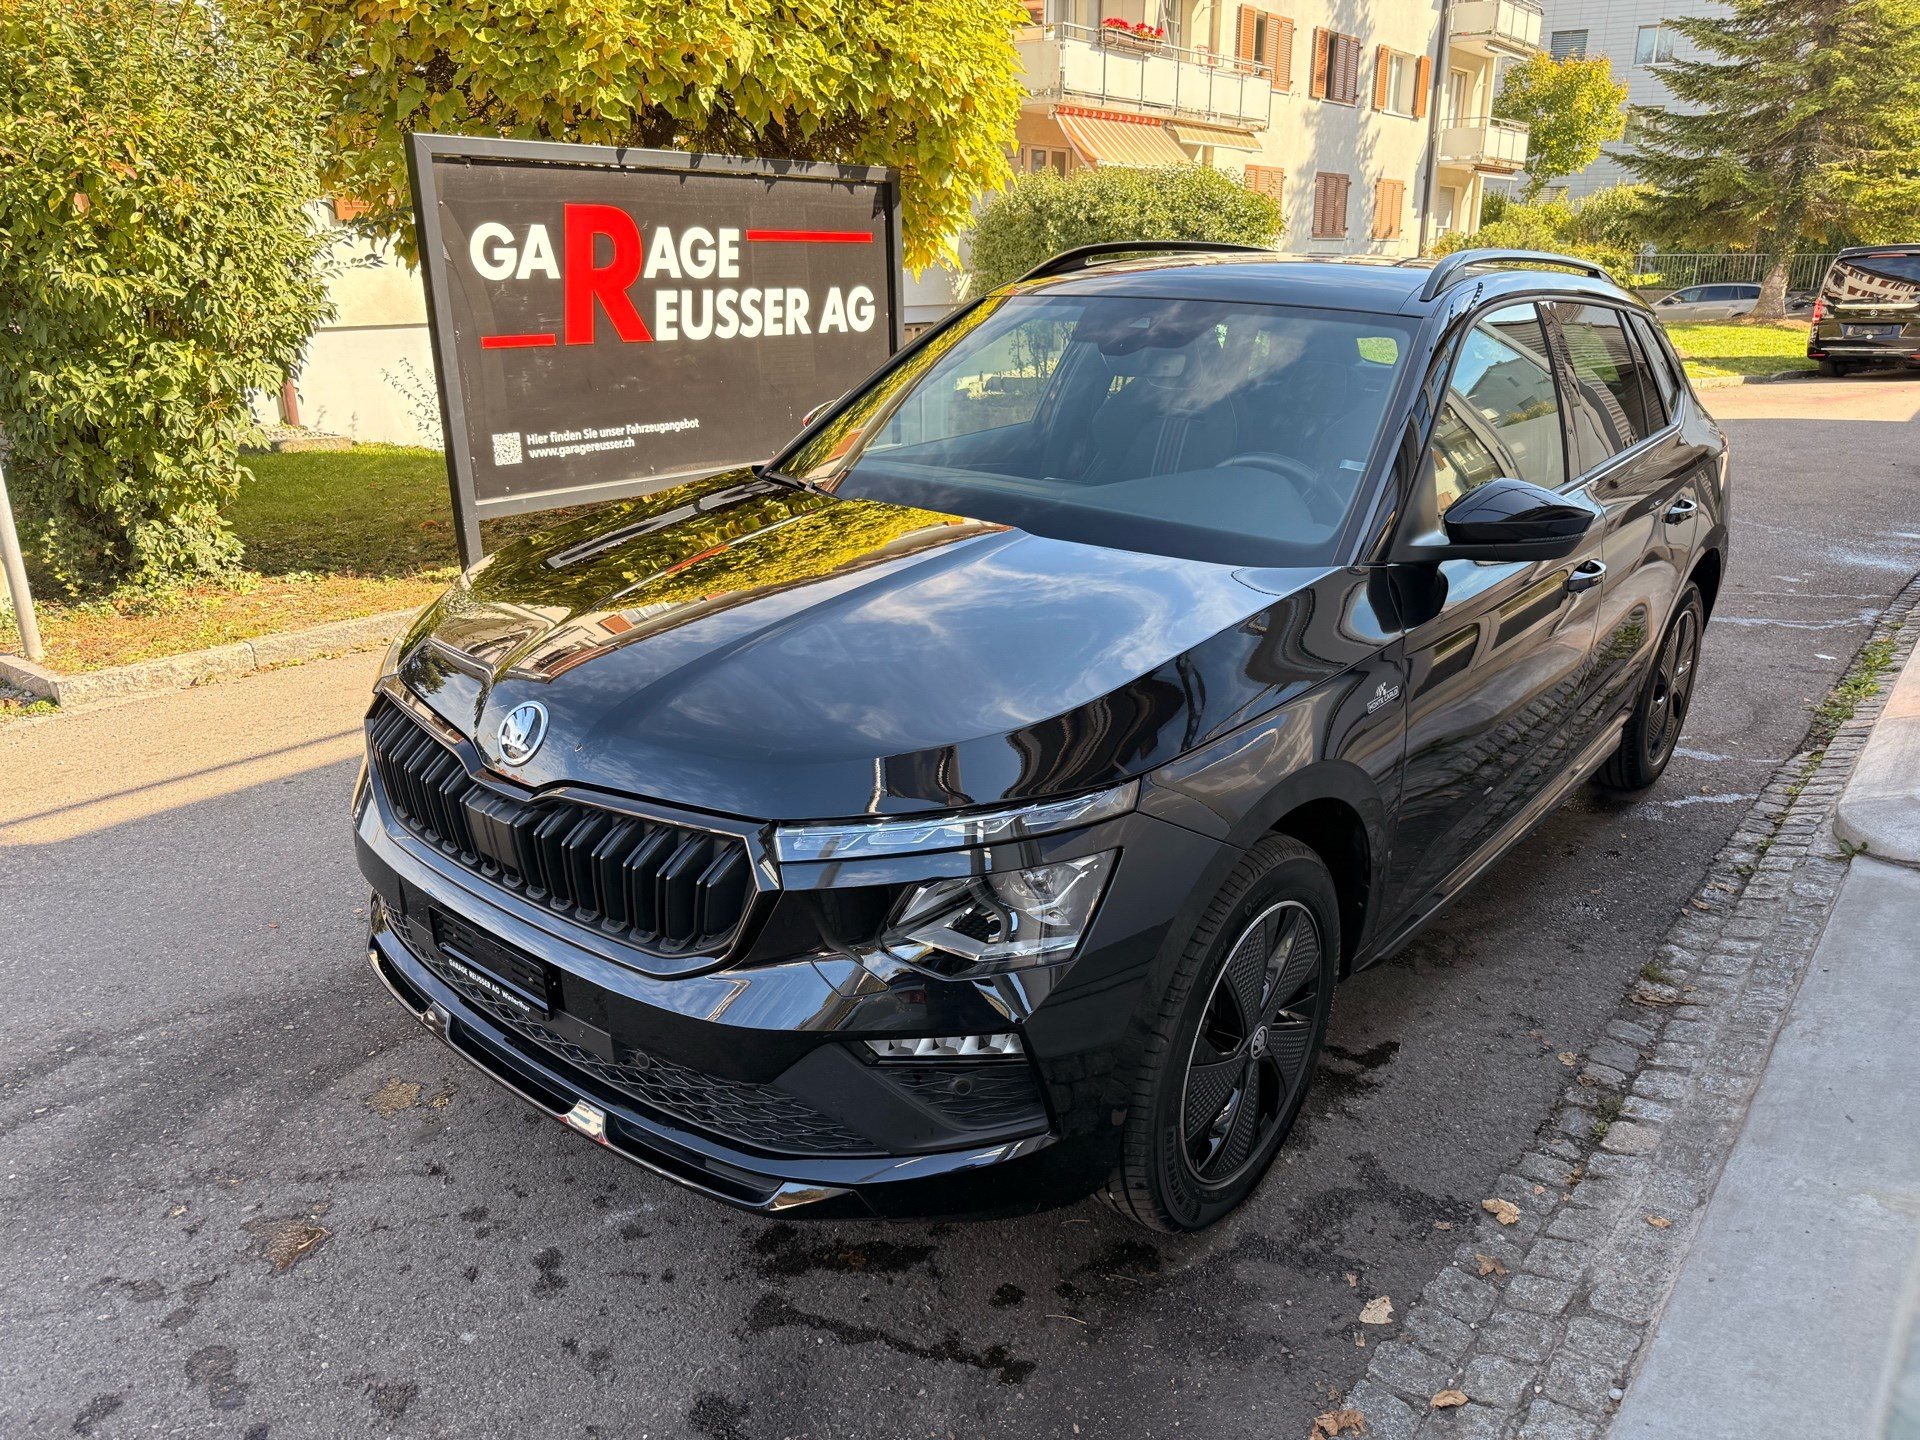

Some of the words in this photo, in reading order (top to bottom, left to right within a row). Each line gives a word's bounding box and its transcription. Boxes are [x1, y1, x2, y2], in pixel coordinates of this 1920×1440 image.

[469, 203, 740, 345] GARAGE
[818, 286, 876, 334] AG
[526, 434, 549, 445] Hier
[550, 430, 582, 443] finden
[583, 427, 598, 439] Sie
[599, 426, 625, 438] unser
[626, 418, 700, 435] Fahrzeugangebot
[528, 437, 635, 458] www.garagereusser.ch
[448, 959, 468, 976] GARAGE
